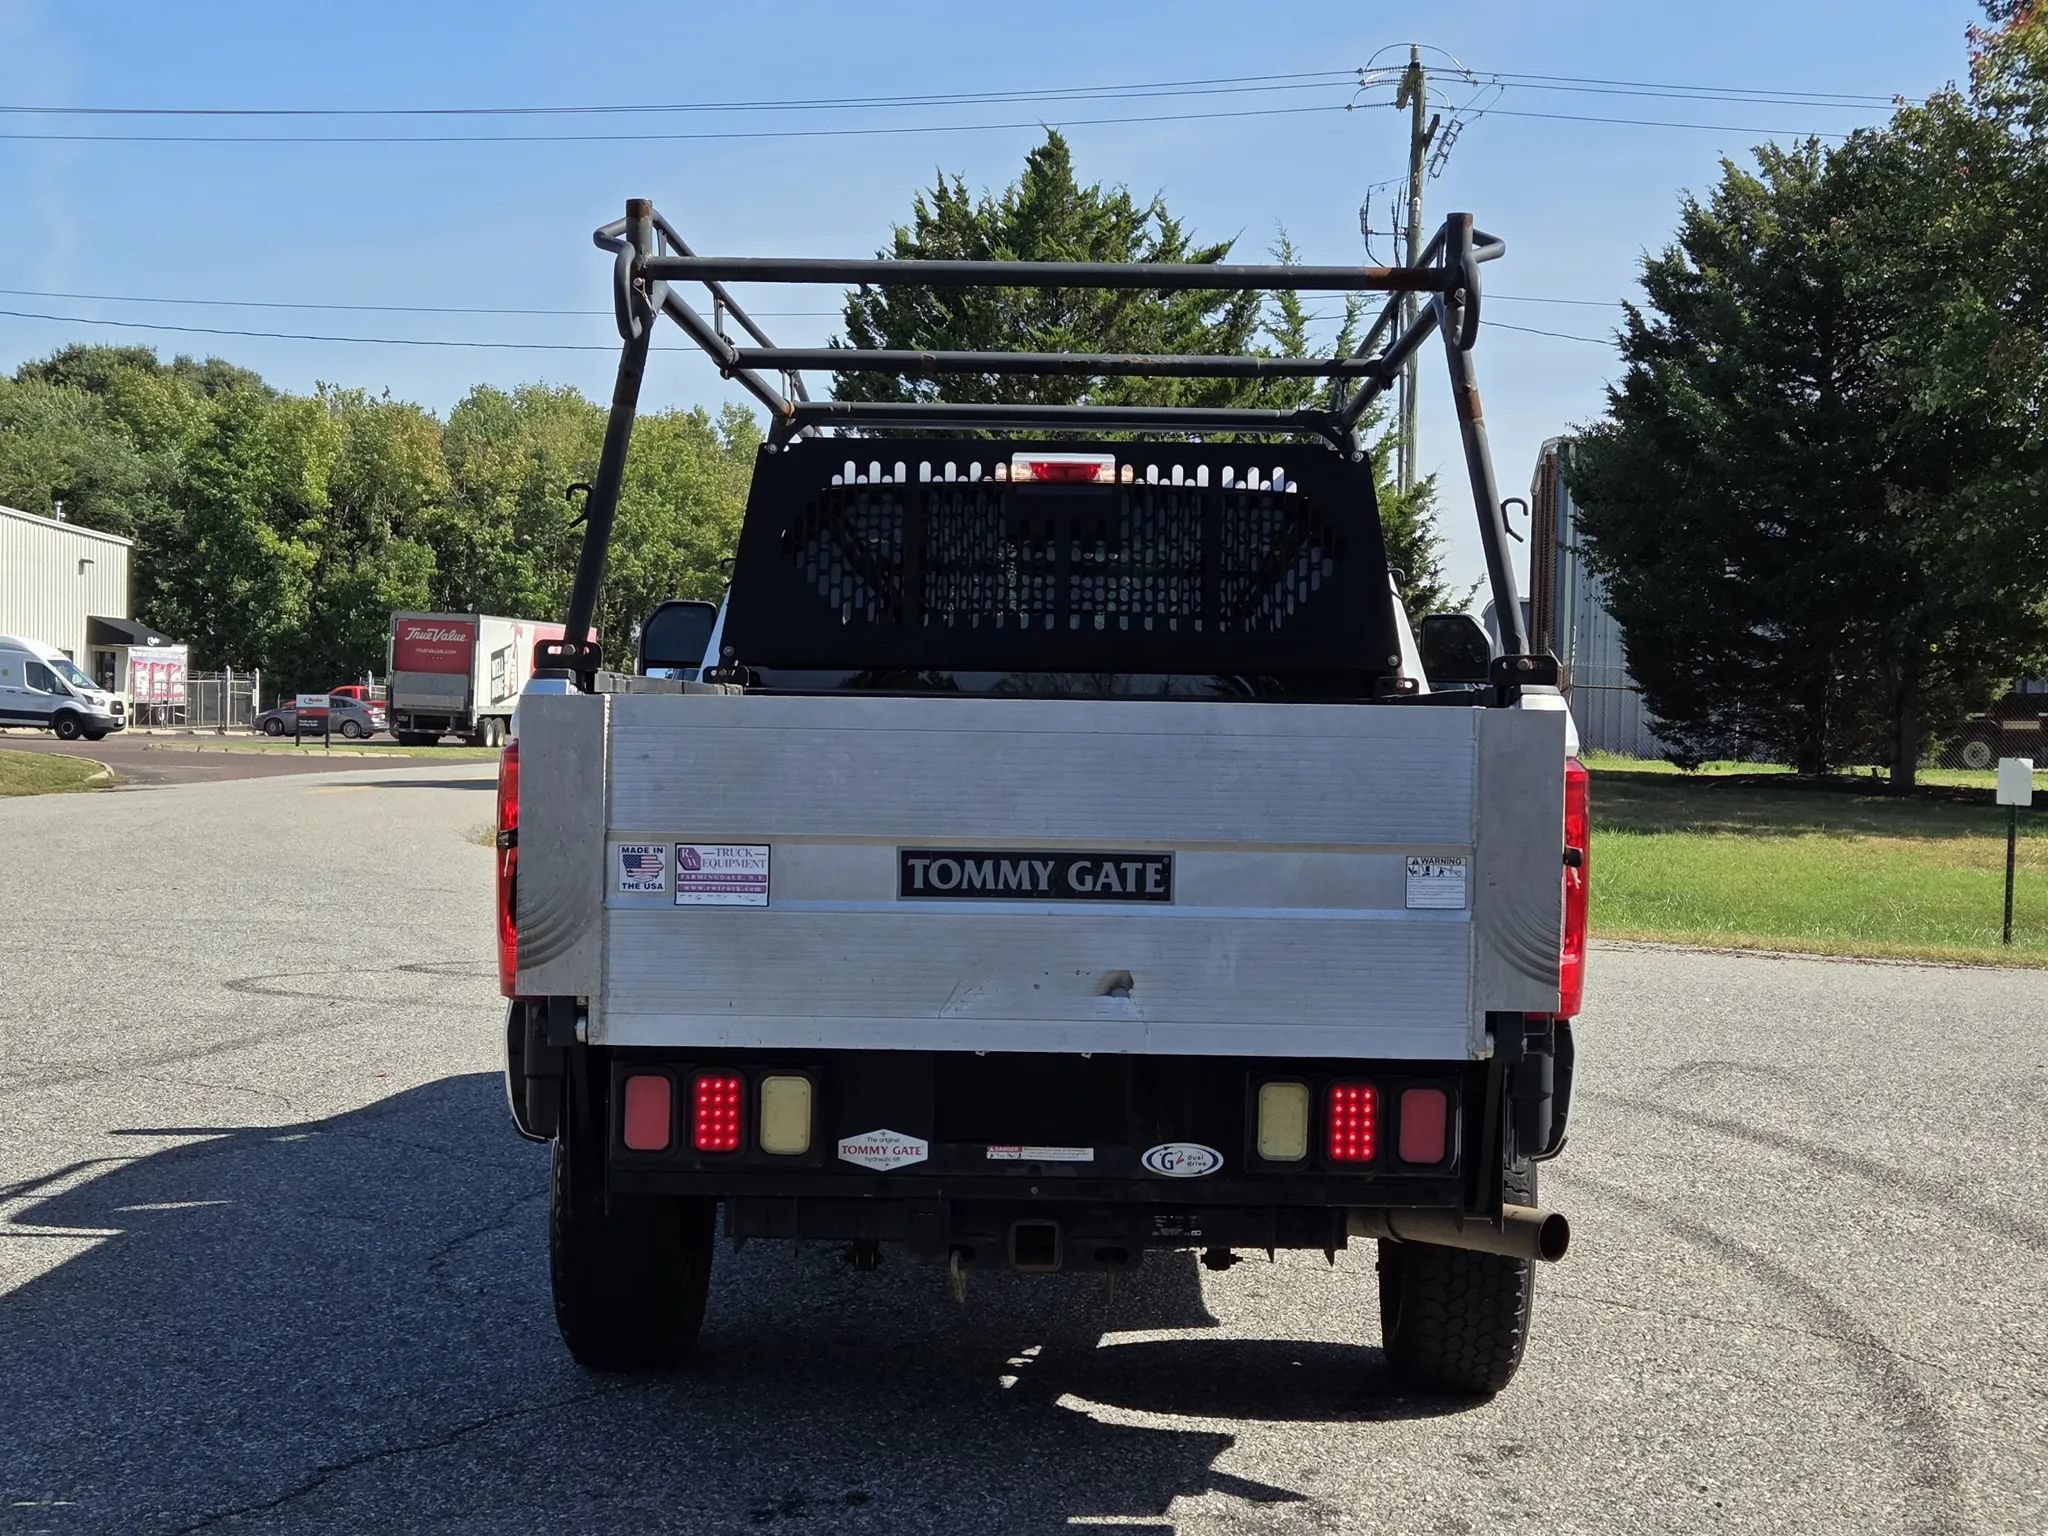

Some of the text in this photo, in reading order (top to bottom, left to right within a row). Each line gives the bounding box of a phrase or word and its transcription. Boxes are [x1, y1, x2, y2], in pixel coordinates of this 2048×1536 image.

[716, 847, 753, 857] TRUCK
[702, 858, 766, 869] EQUIPMENT
[1421, 857, 1462, 865] WARNING
[907, 858, 1166, 893] TOMMY GATE
[841, 1145, 922, 1155] TOMMY GATE
